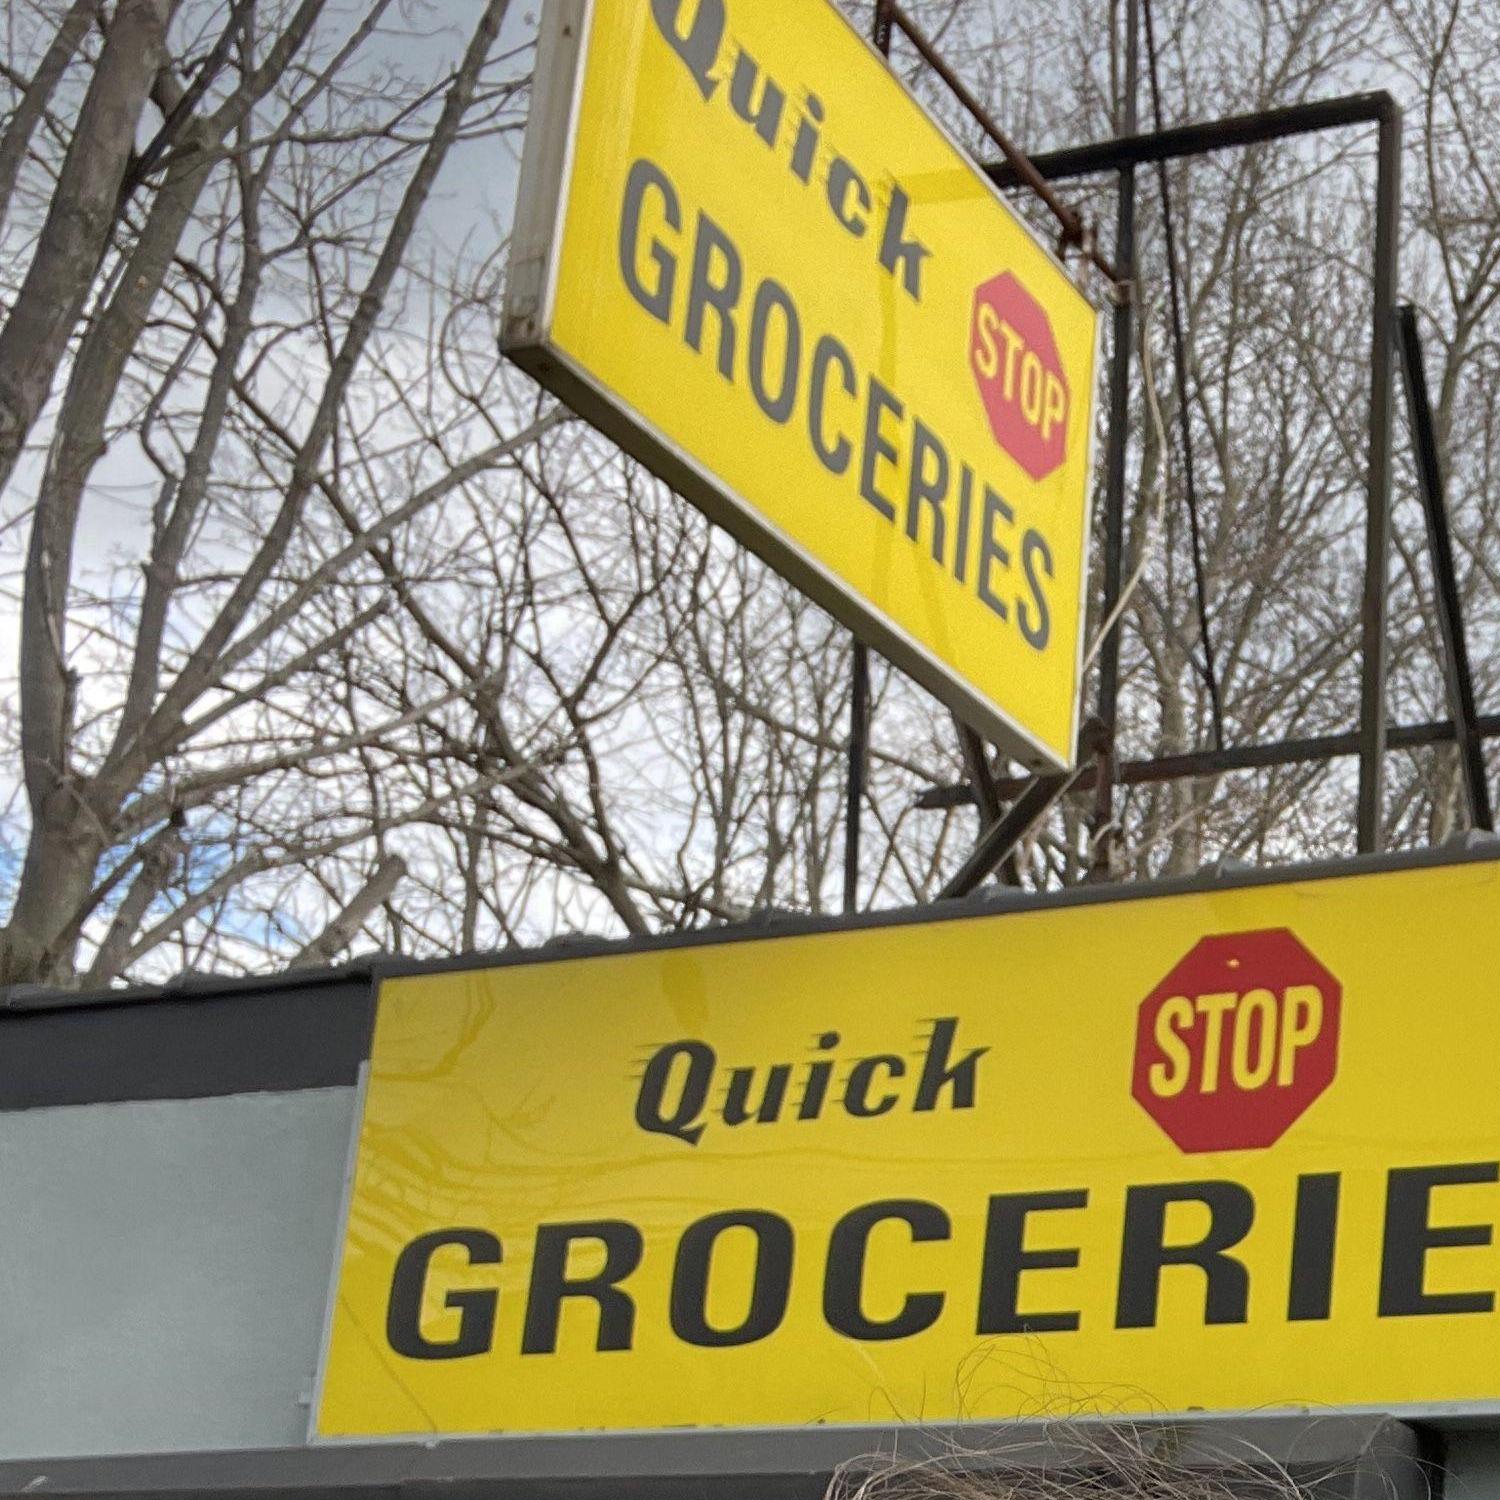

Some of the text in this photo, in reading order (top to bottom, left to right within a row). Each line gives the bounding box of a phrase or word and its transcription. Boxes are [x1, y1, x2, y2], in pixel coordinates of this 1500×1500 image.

[650, 0, 933, 303] Quick
[618, 158, 1055, 652] GROCERIES
[975, 302, 1068, 443] STOP
[631, 1016, 991, 1146] Quick
[1148, 984, 1324, 1099] STOP
